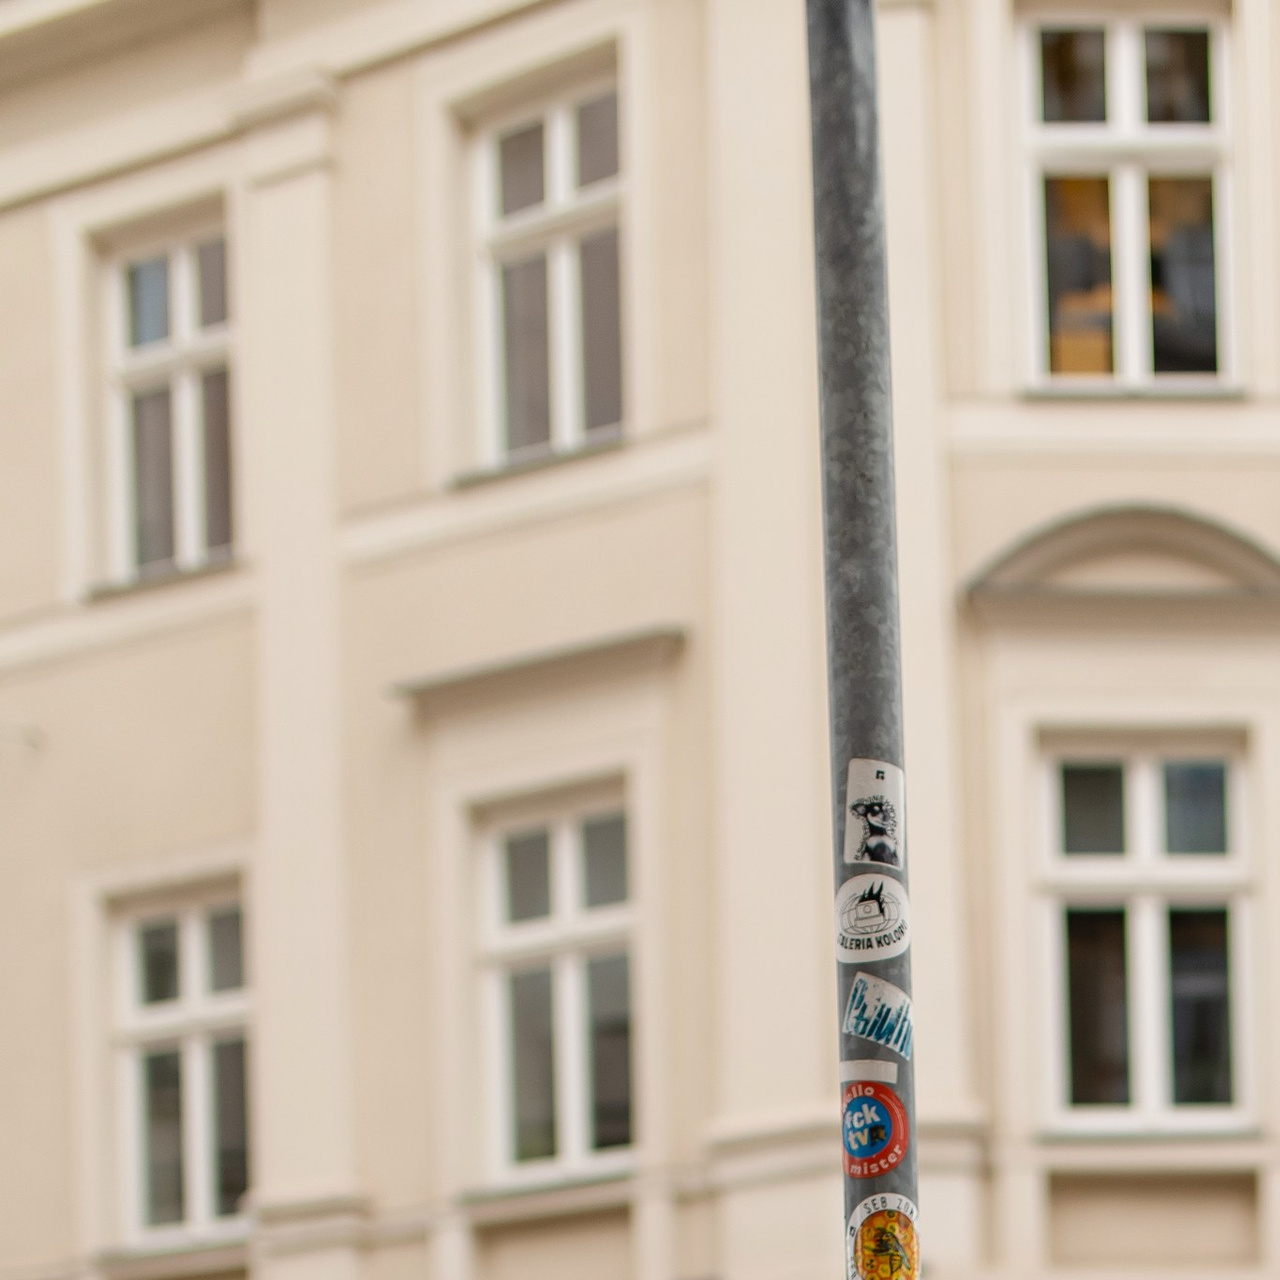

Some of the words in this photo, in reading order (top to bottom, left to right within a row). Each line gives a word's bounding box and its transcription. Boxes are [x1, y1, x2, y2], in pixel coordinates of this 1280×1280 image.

[844, 1103, 881, 1129] fck
[850, 1144, 902, 1175] mister
[863, 1196, 888, 1215] SEB
